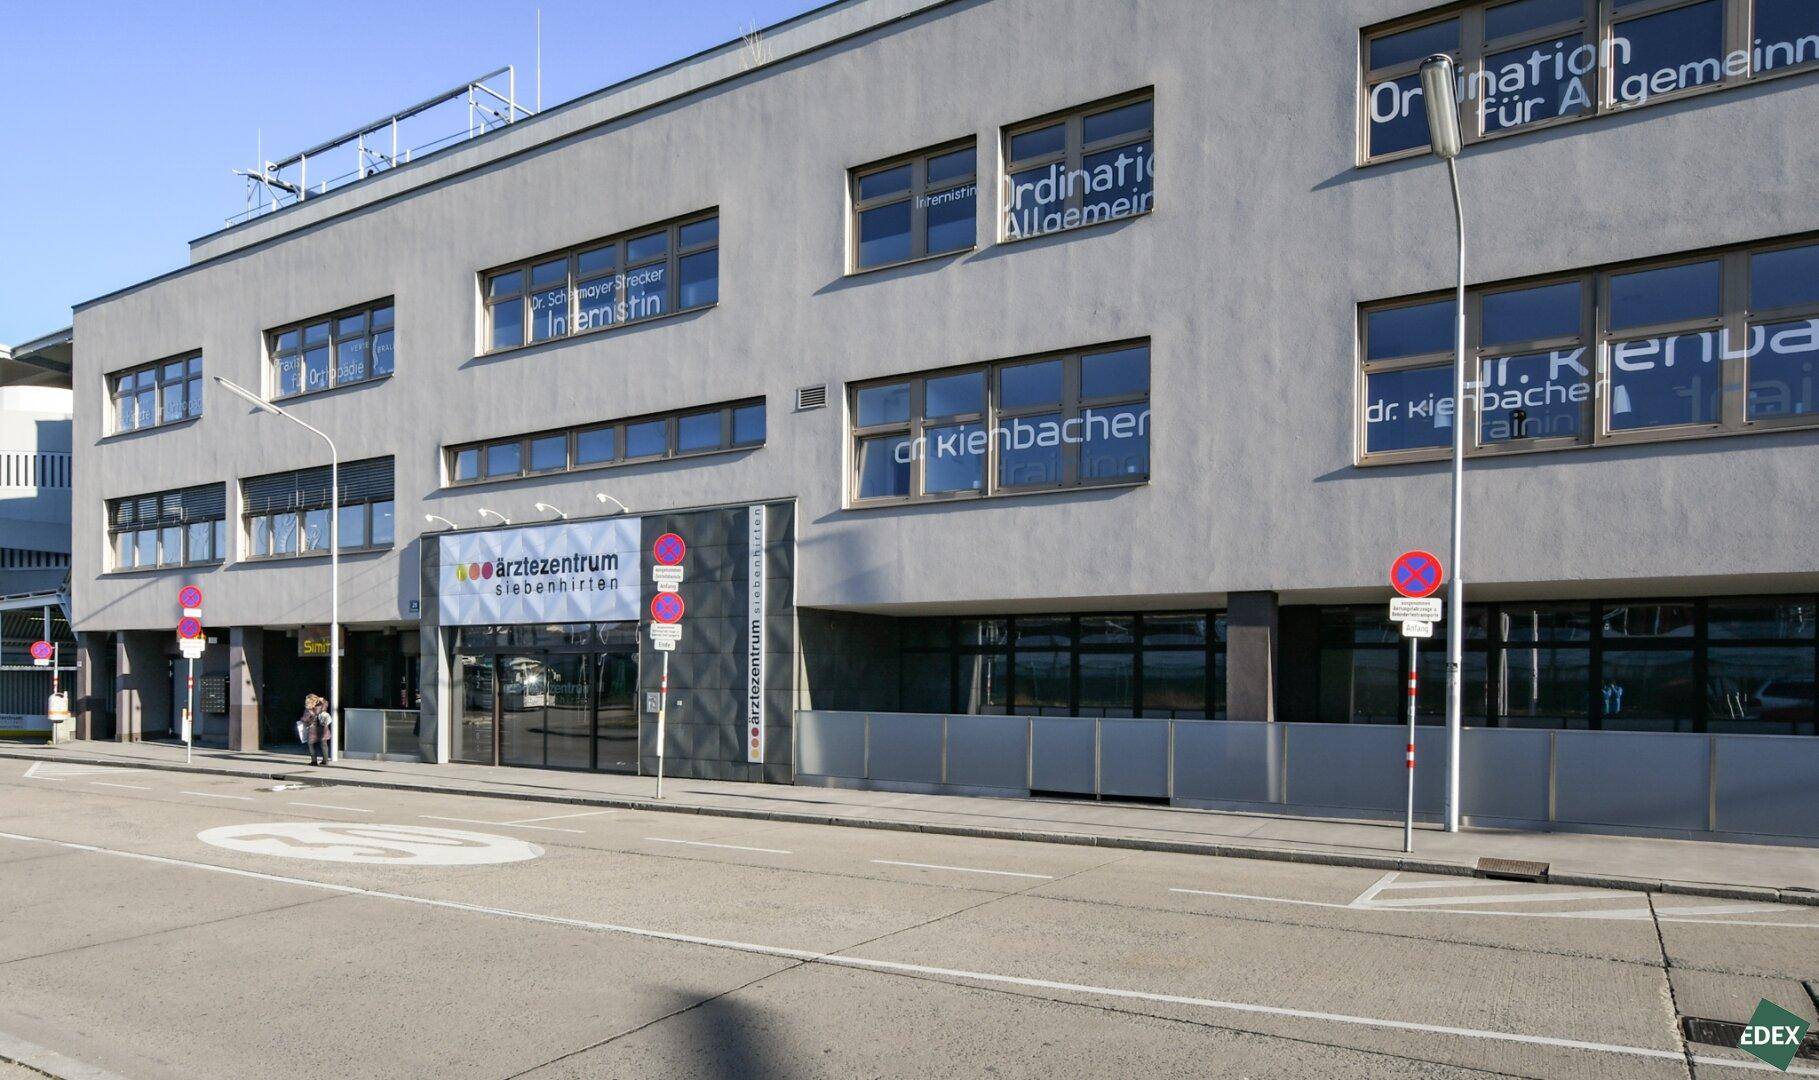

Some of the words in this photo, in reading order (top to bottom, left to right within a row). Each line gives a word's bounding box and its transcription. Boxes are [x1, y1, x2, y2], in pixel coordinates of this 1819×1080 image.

[1370, 36, 1632, 123] Orination
[1476, 95, 1545, 128] für
[916, 185, 978, 209] Internistin
[532, 296, 546, 311] Dr.
[548, 268, 664, 307] Schemayer-Strecker
[1367, 398, 1398, 423] dr.
[496, 552, 618, 578] ärztezentrum
[753, 508, 761, 614] siebenhirten
[495, 577, 618, 596] siebenhirten
[1405, 624, 1430, 634] Anfang
[749, 619, 761, 725] ärztezentrum
